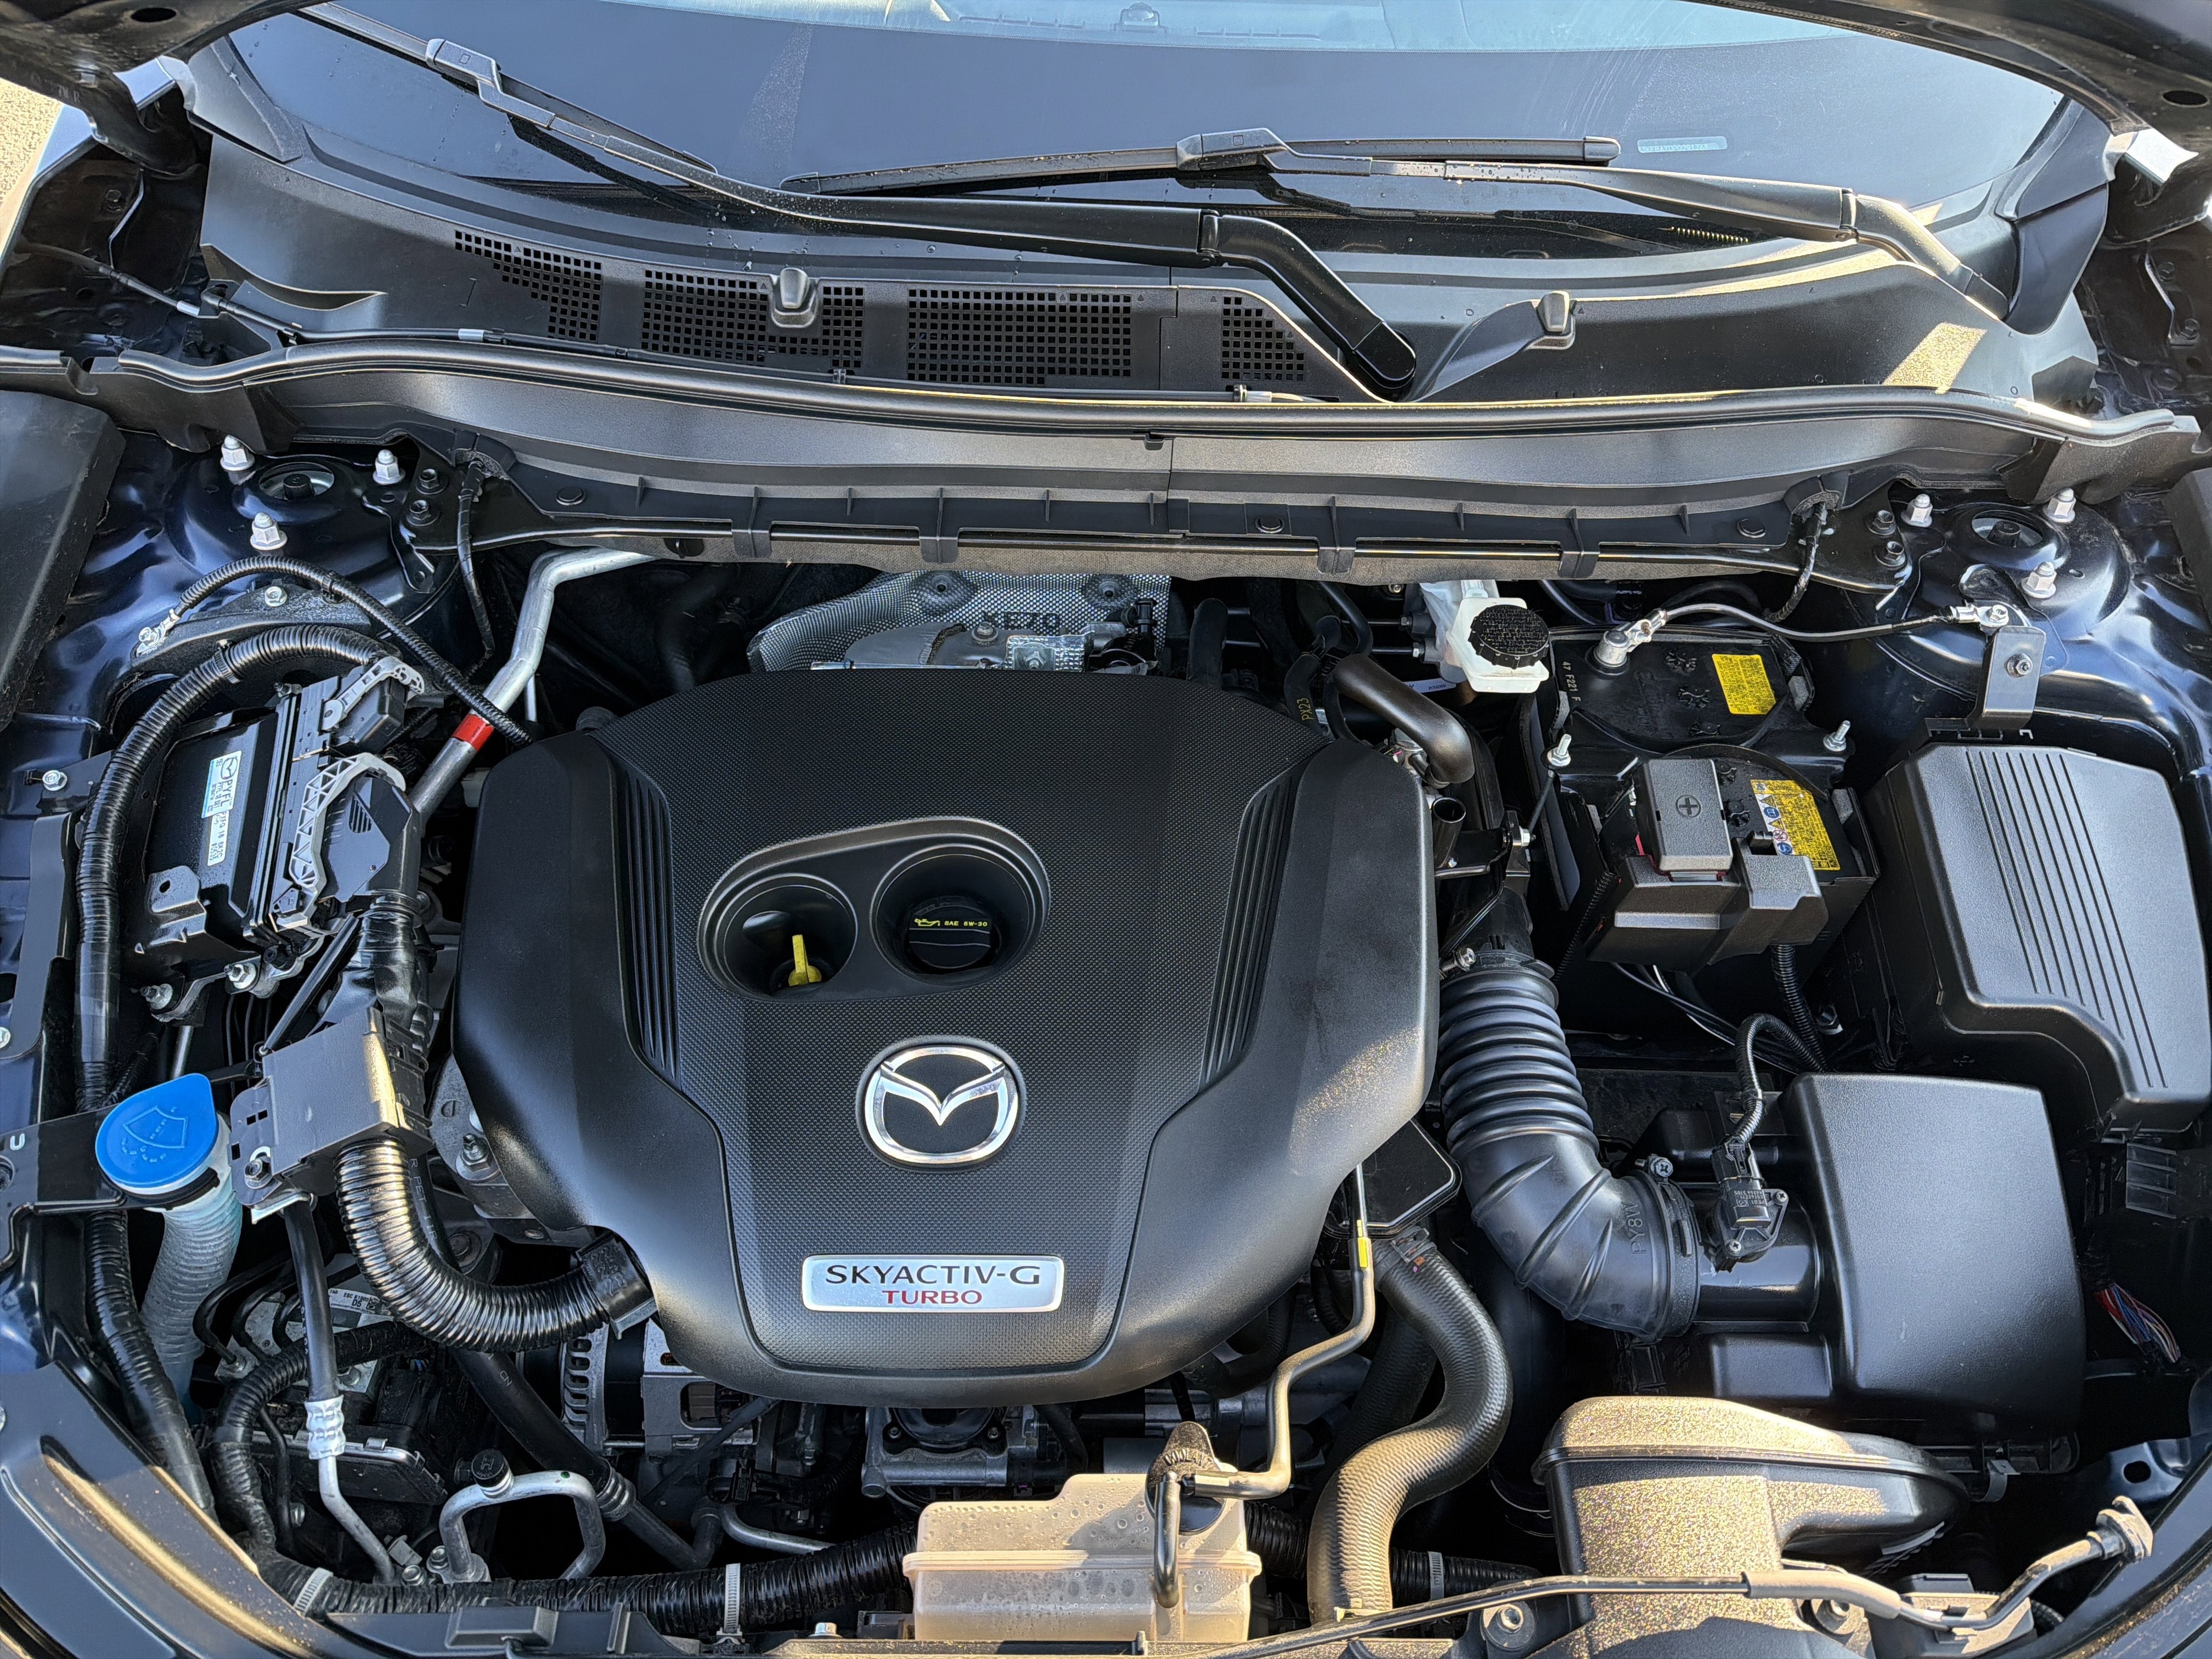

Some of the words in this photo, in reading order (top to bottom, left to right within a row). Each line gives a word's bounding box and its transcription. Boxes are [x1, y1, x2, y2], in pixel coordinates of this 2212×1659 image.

[220, 779, 233, 806] PYFL
[1622, 1201, 1646, 1255] PY8W
[825, 1265, 1041, 1285] SKYACTIV-G
[352, 1299, 363, 1307] D5
[881, 1290, 983, 1305] TURBO
